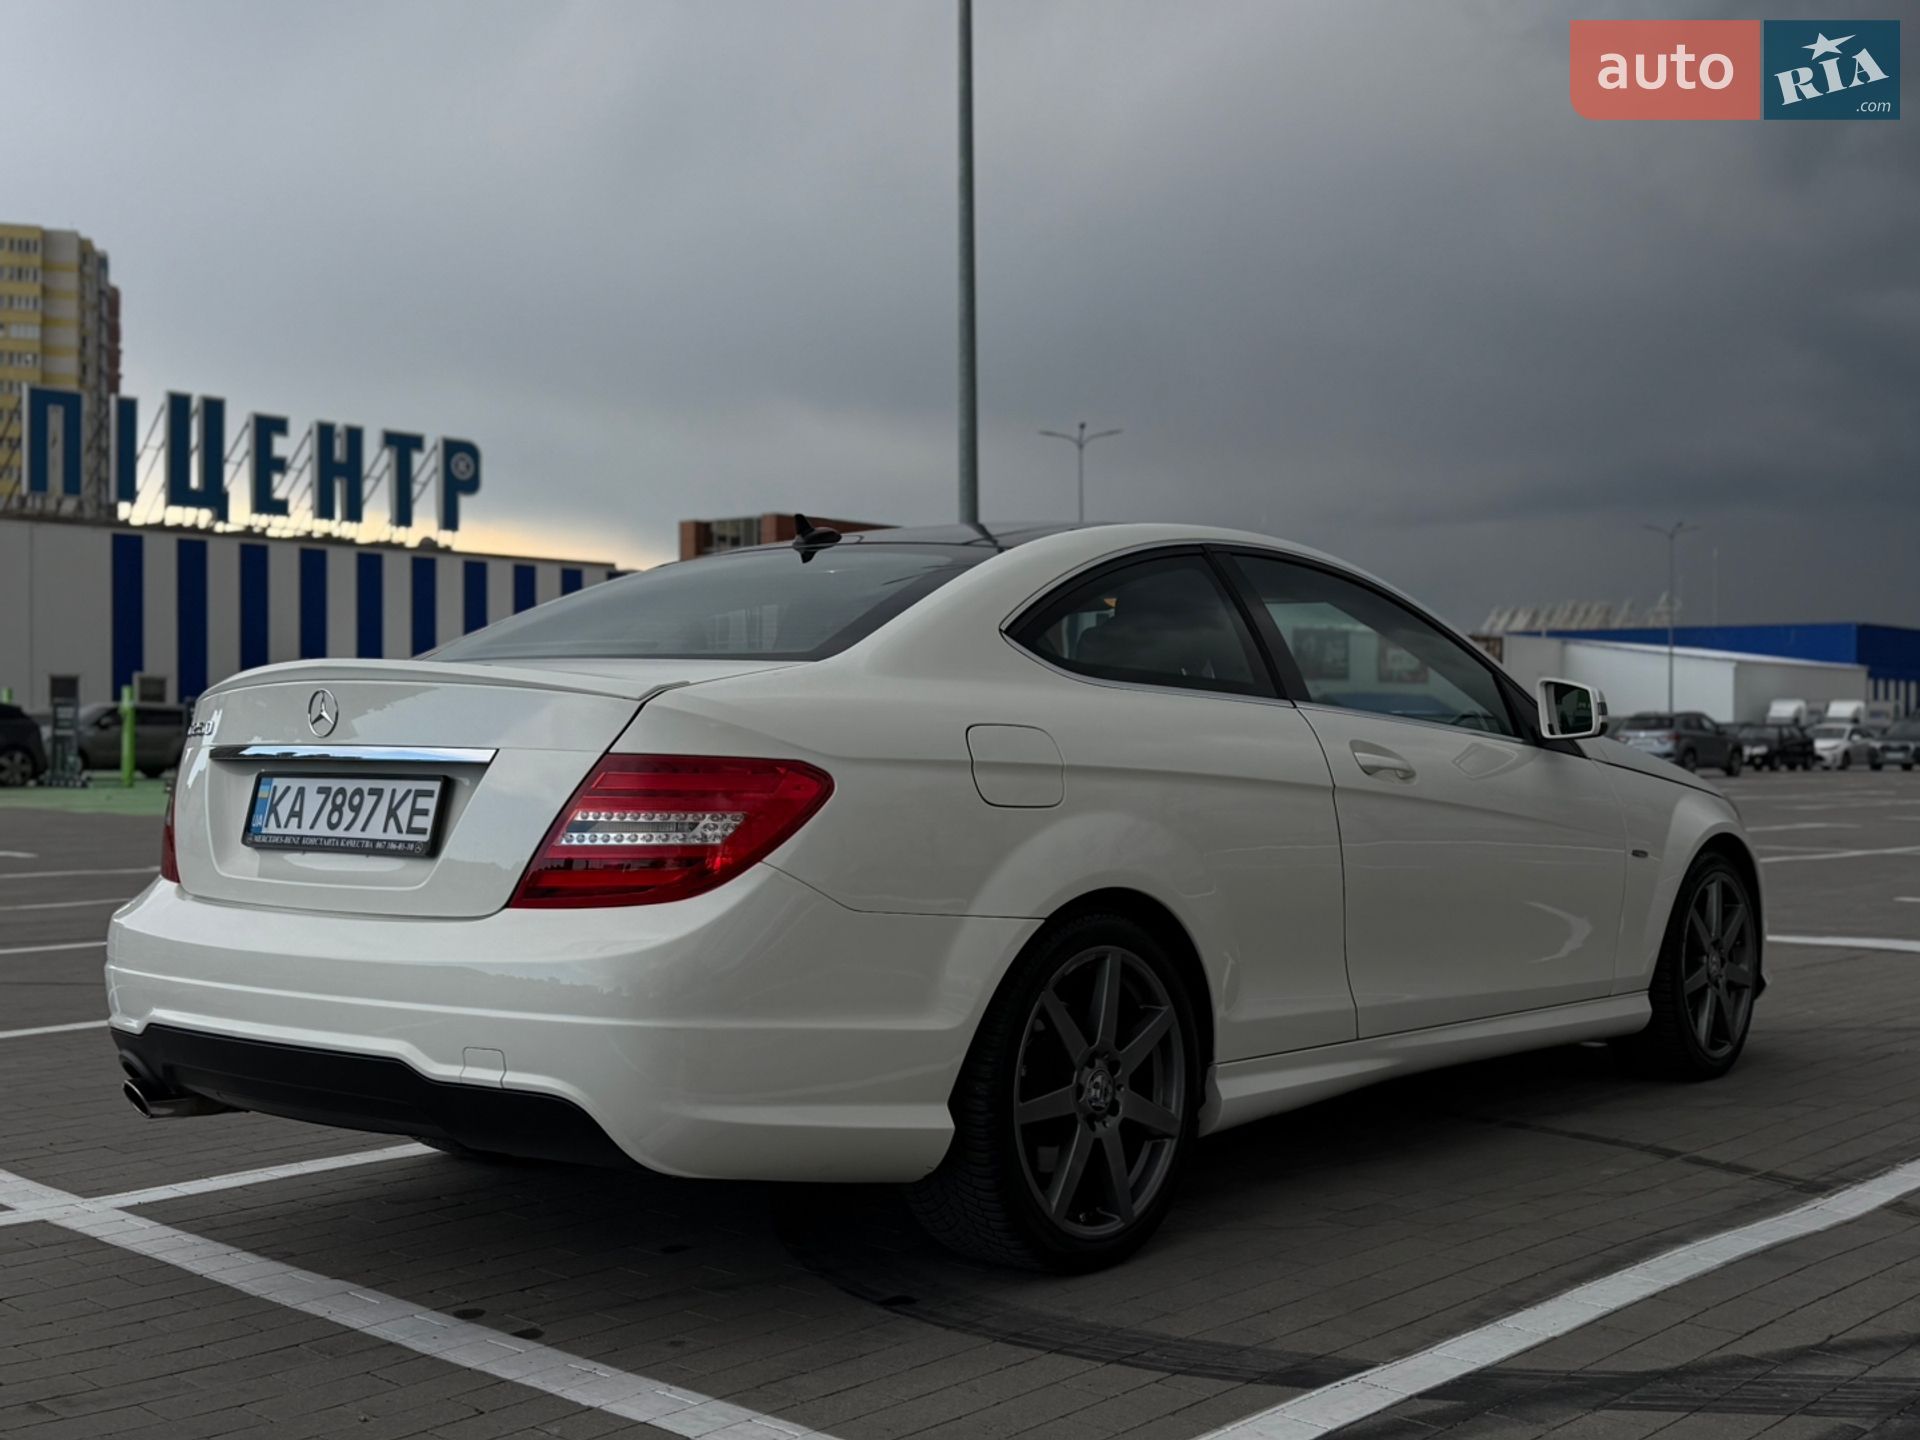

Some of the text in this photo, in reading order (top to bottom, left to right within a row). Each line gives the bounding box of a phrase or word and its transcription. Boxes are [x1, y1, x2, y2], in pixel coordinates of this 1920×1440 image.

[22, 386, 482, 532] ПІЦЕНТР
[264, 785, 436, 835] KA 7897 KE
